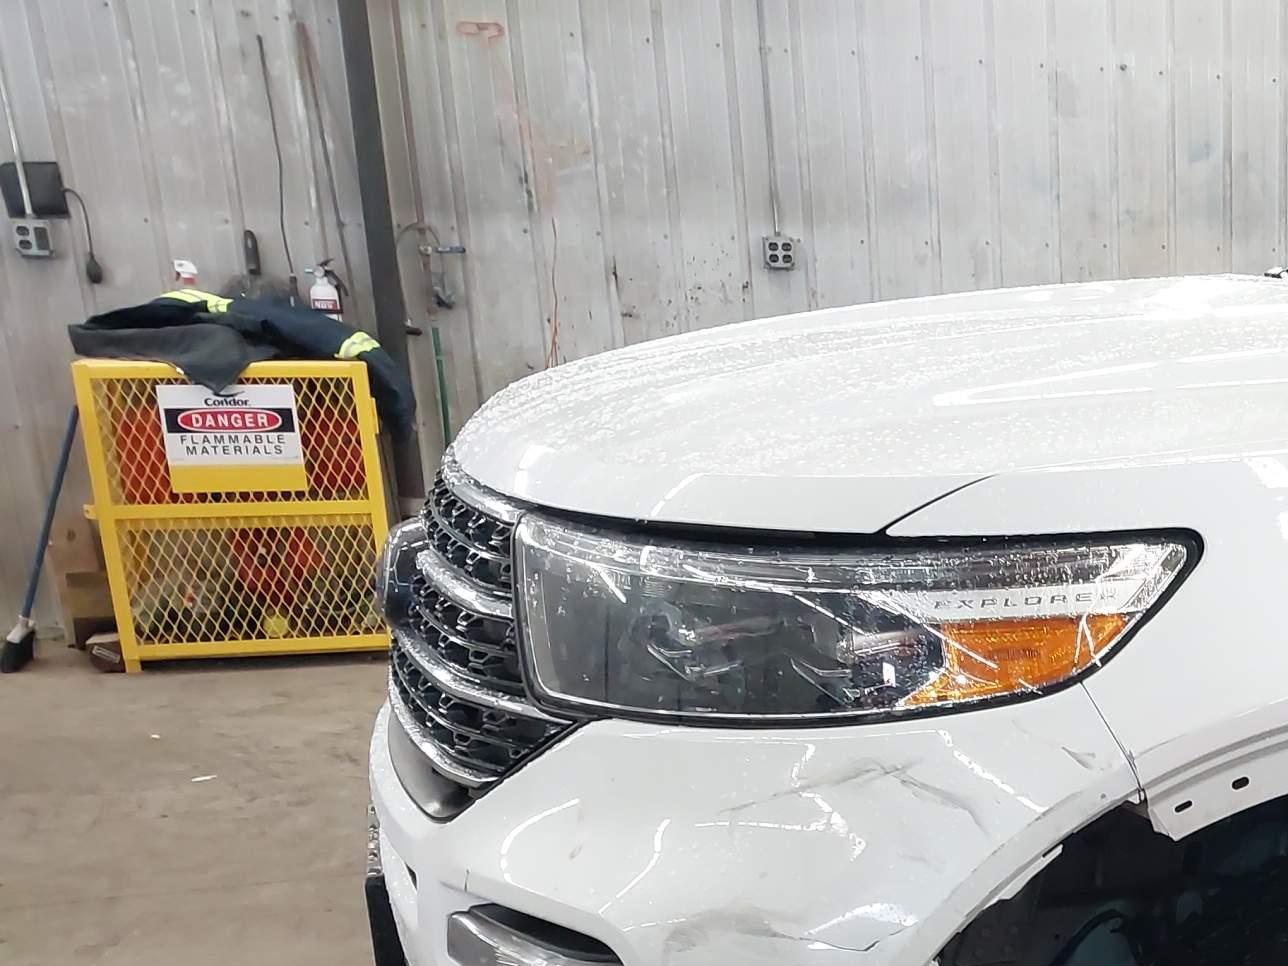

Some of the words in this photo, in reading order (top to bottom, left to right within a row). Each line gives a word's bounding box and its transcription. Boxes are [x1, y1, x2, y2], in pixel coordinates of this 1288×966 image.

[204, 398, 250, 407] Condor
[191, 413, 269, 428] DANGER
[180, 434, 286, 445] FLAMMABLE
[186, 445, 284, 456] MATERIALS
[934, 590, 1116, 609] EXPLORER
